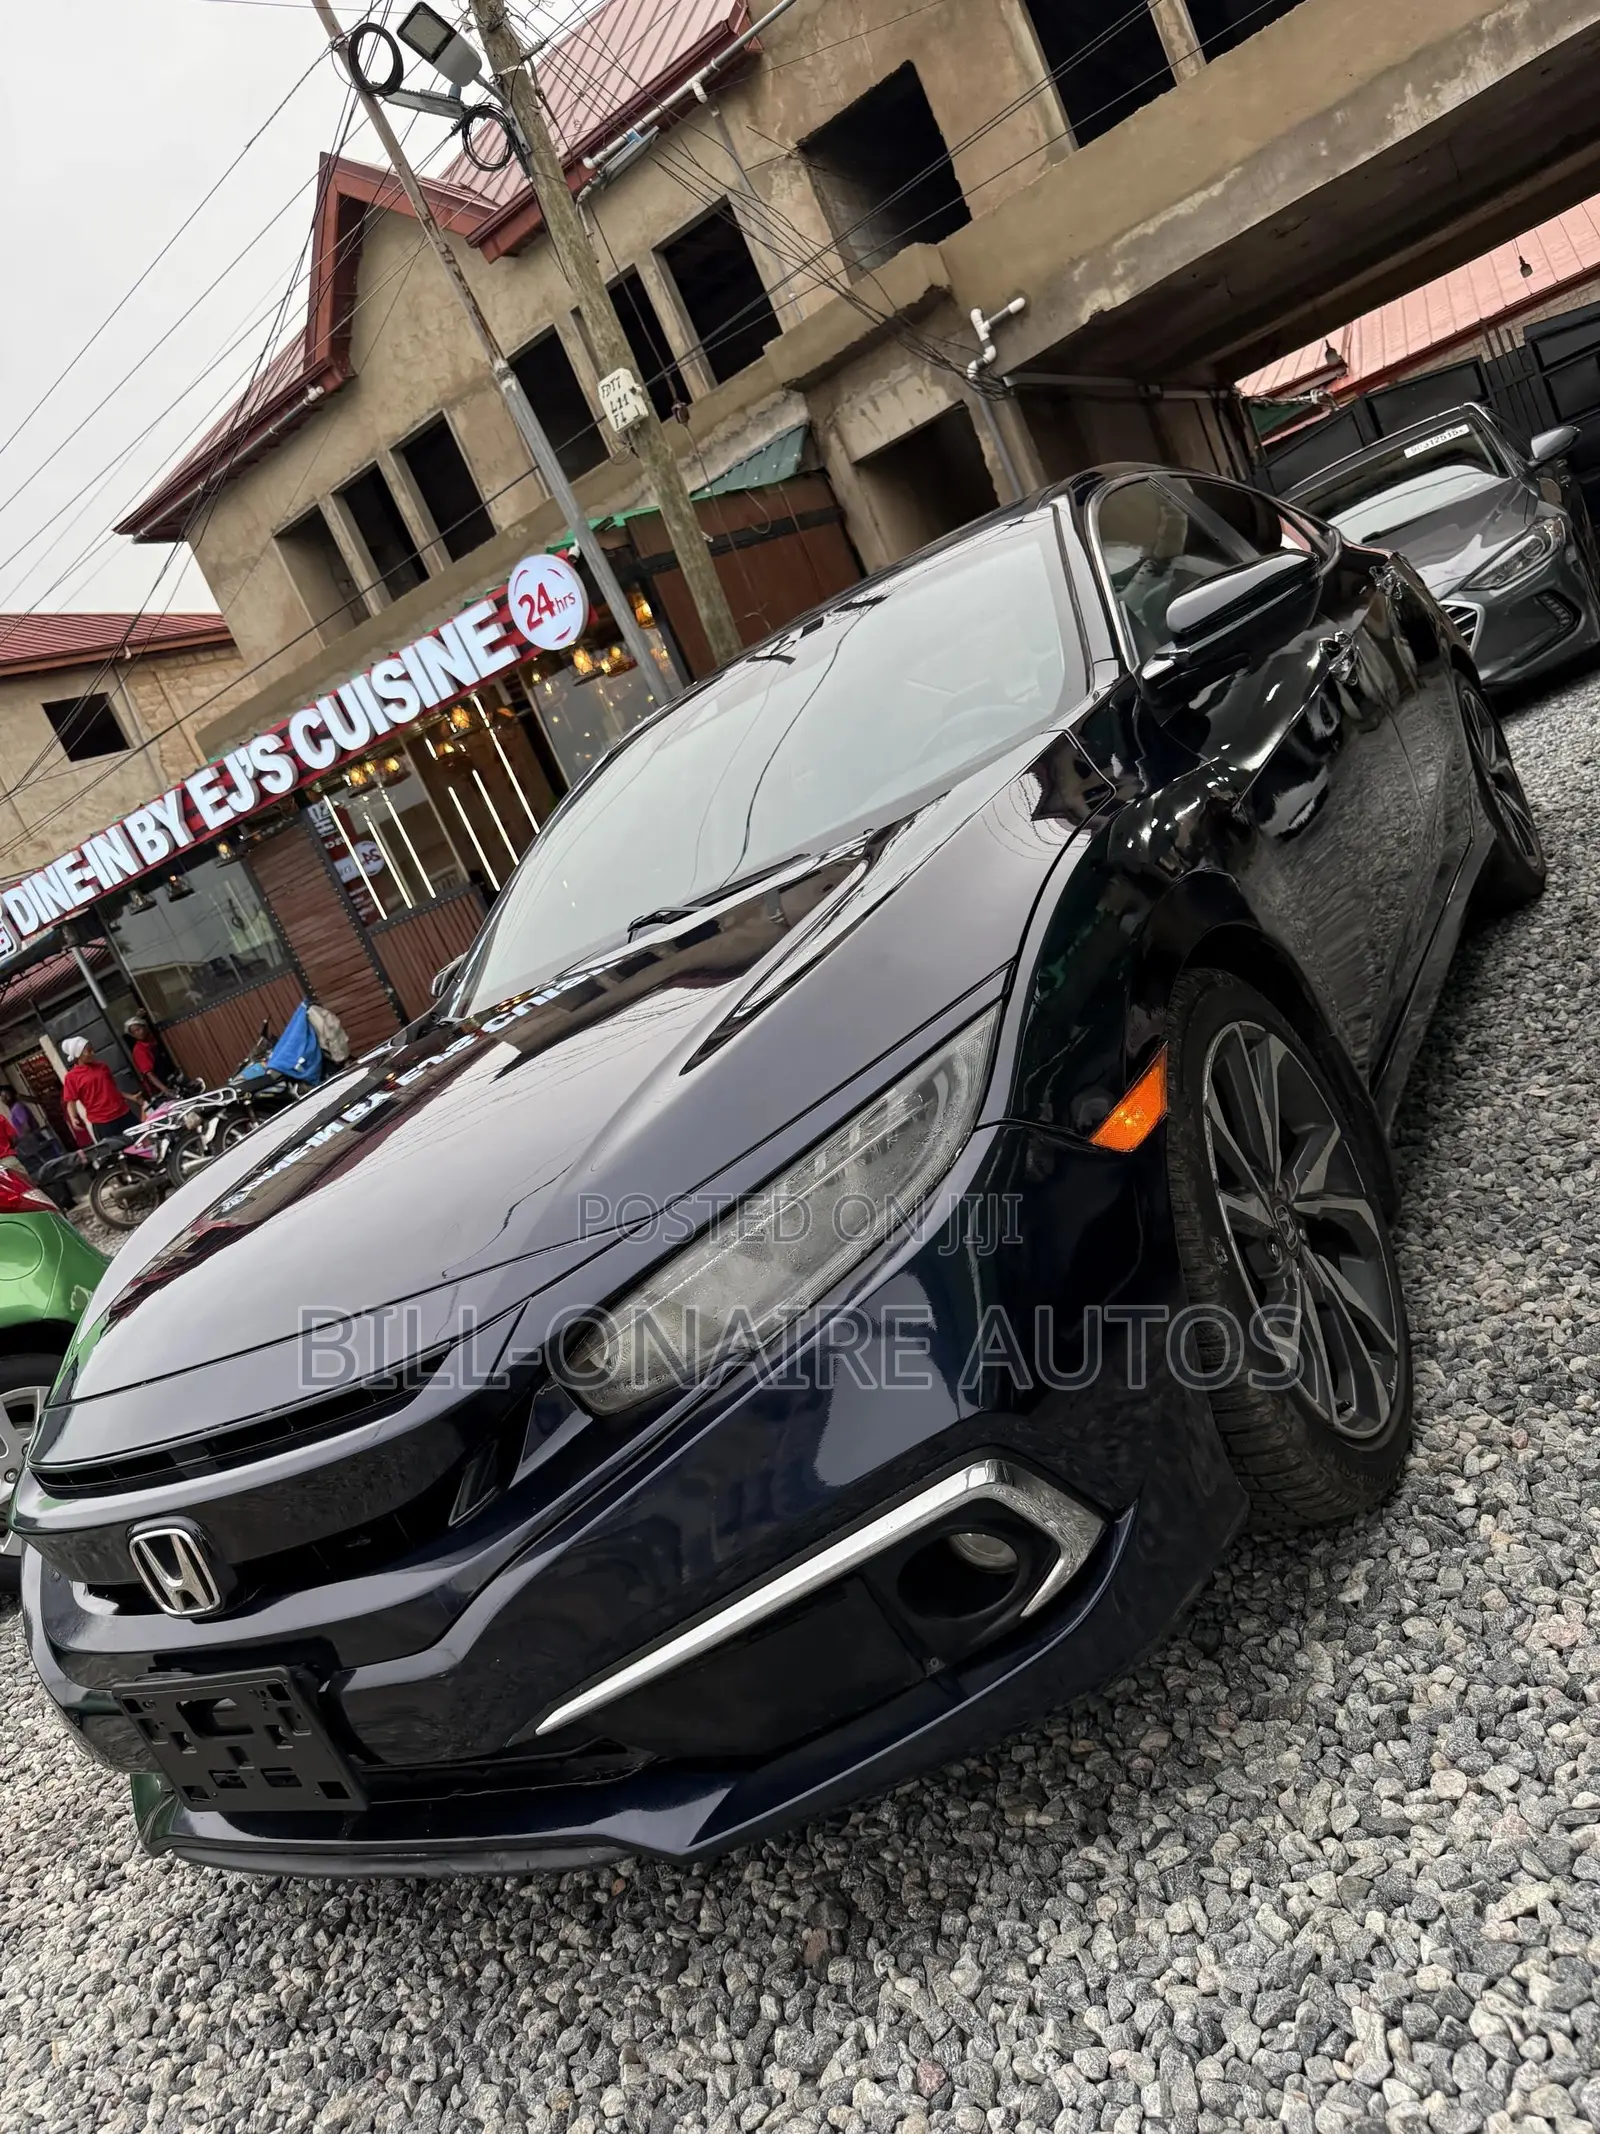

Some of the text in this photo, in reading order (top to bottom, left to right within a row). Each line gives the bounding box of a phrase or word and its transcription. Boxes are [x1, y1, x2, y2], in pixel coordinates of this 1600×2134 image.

[5, 825, 140, 936] DINE-IN
[124, 787, 195, 864] BY
[185, 735, 297, 830] EJ'S
[288, 600, 520, 770] CUISINE
